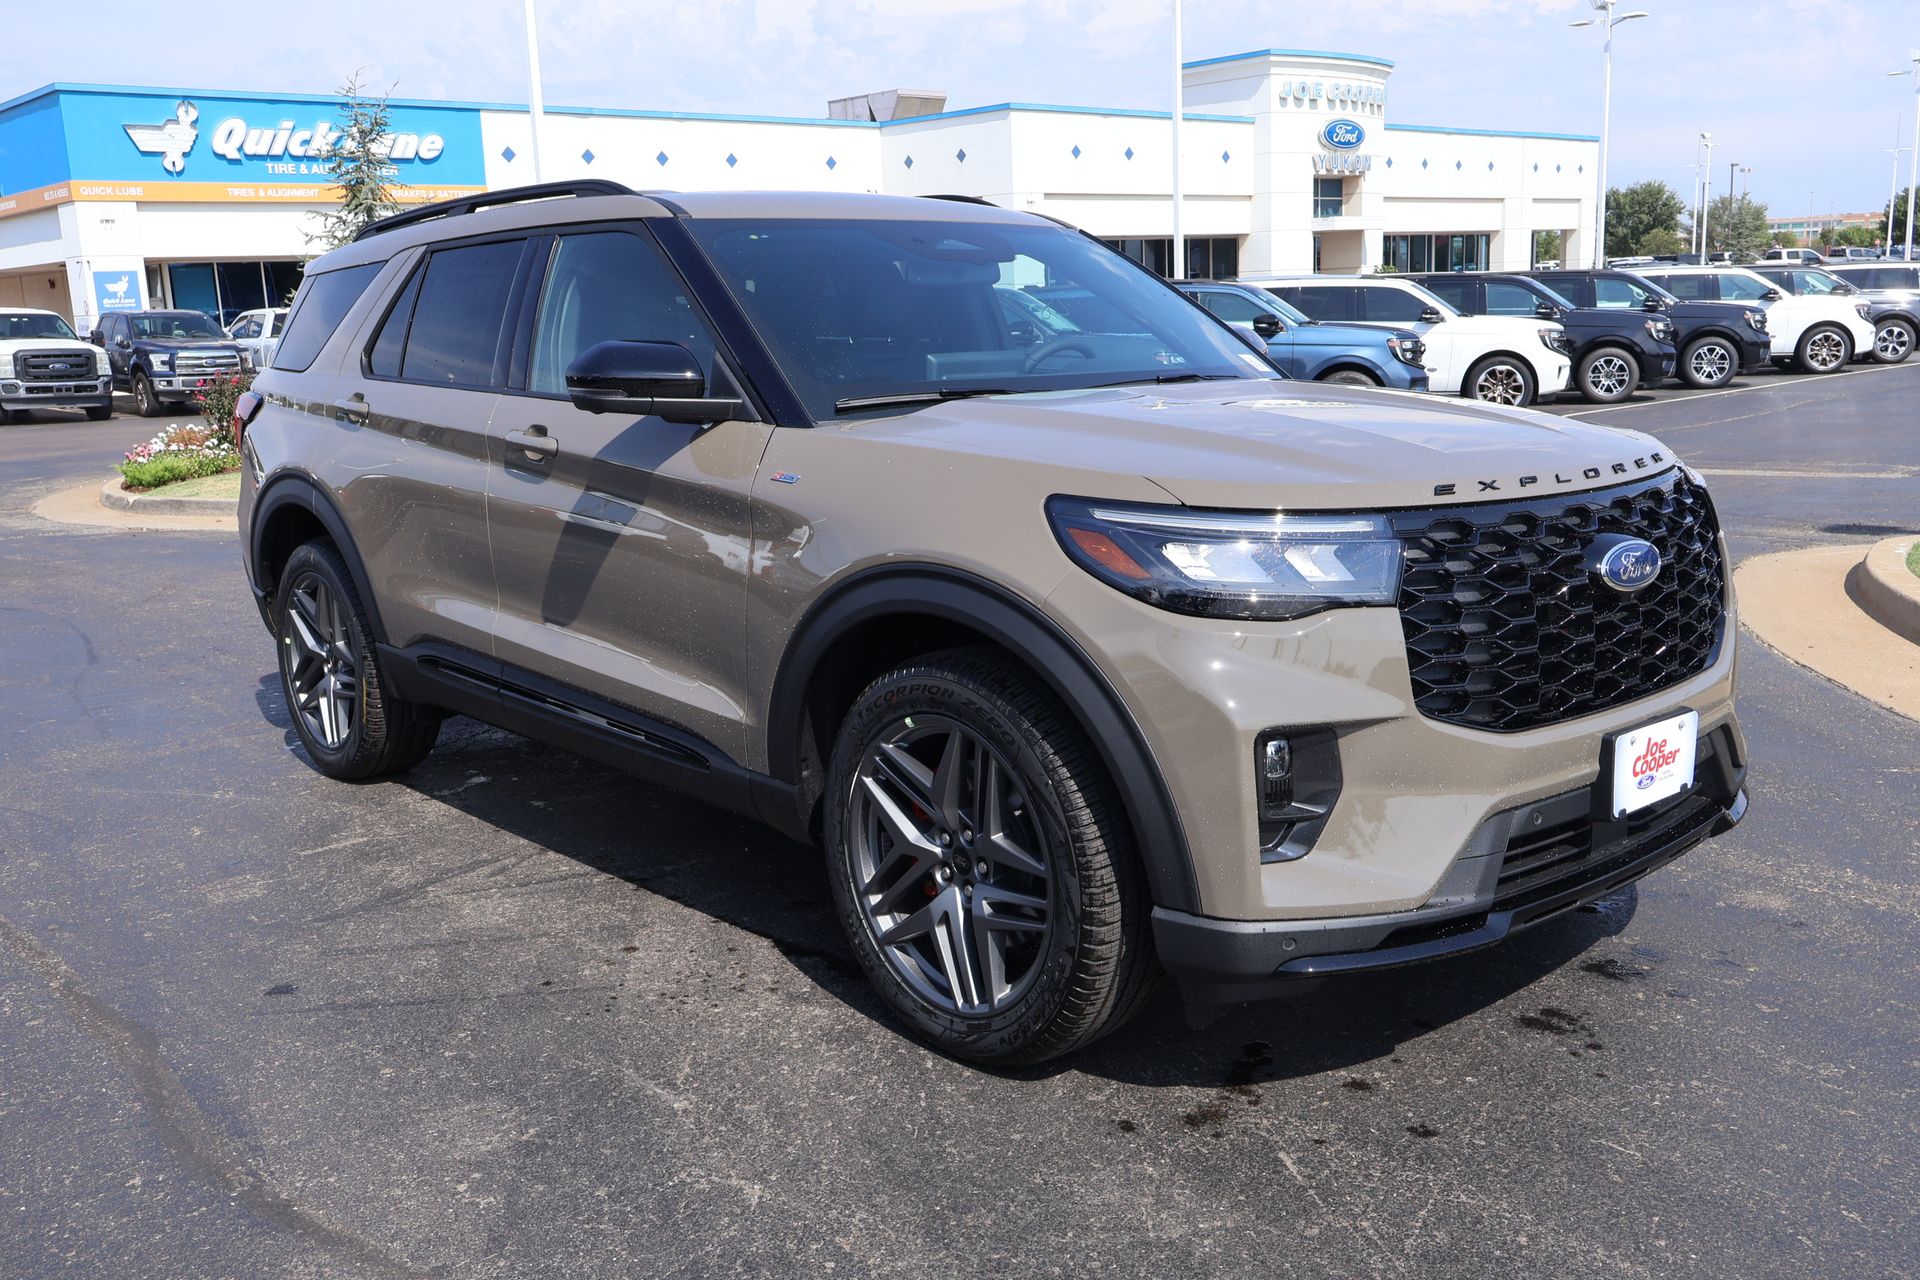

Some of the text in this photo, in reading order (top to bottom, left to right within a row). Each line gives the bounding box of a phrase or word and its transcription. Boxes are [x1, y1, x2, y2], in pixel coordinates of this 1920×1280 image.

[1280, 81, 1323, 100] JOE
[211, 118, 344, 159] Quick
[1332, 123, 1359, 144] Ford
[266, 163, 297, 175] TIRE
[299, 164, 309, 175] &
[1315, 154, 1371, 171] YUKON
[79, 186, 114, 196] QUICK
[115, 187, 144, 196] LUBE
[226, 187, 320, 197] TIRES & ALIGNMENT
[391, 190, 426, 198] BRAKES
[1434, 452, 1664, 497] EXPLORER
[1619, 550, 1654, 581] Ford
[865, 683, 1017, 747] SCORPION ZERO
[1642, 736, 1668, 761] Joe
[1632, 747, 1681, 778] Cooper
